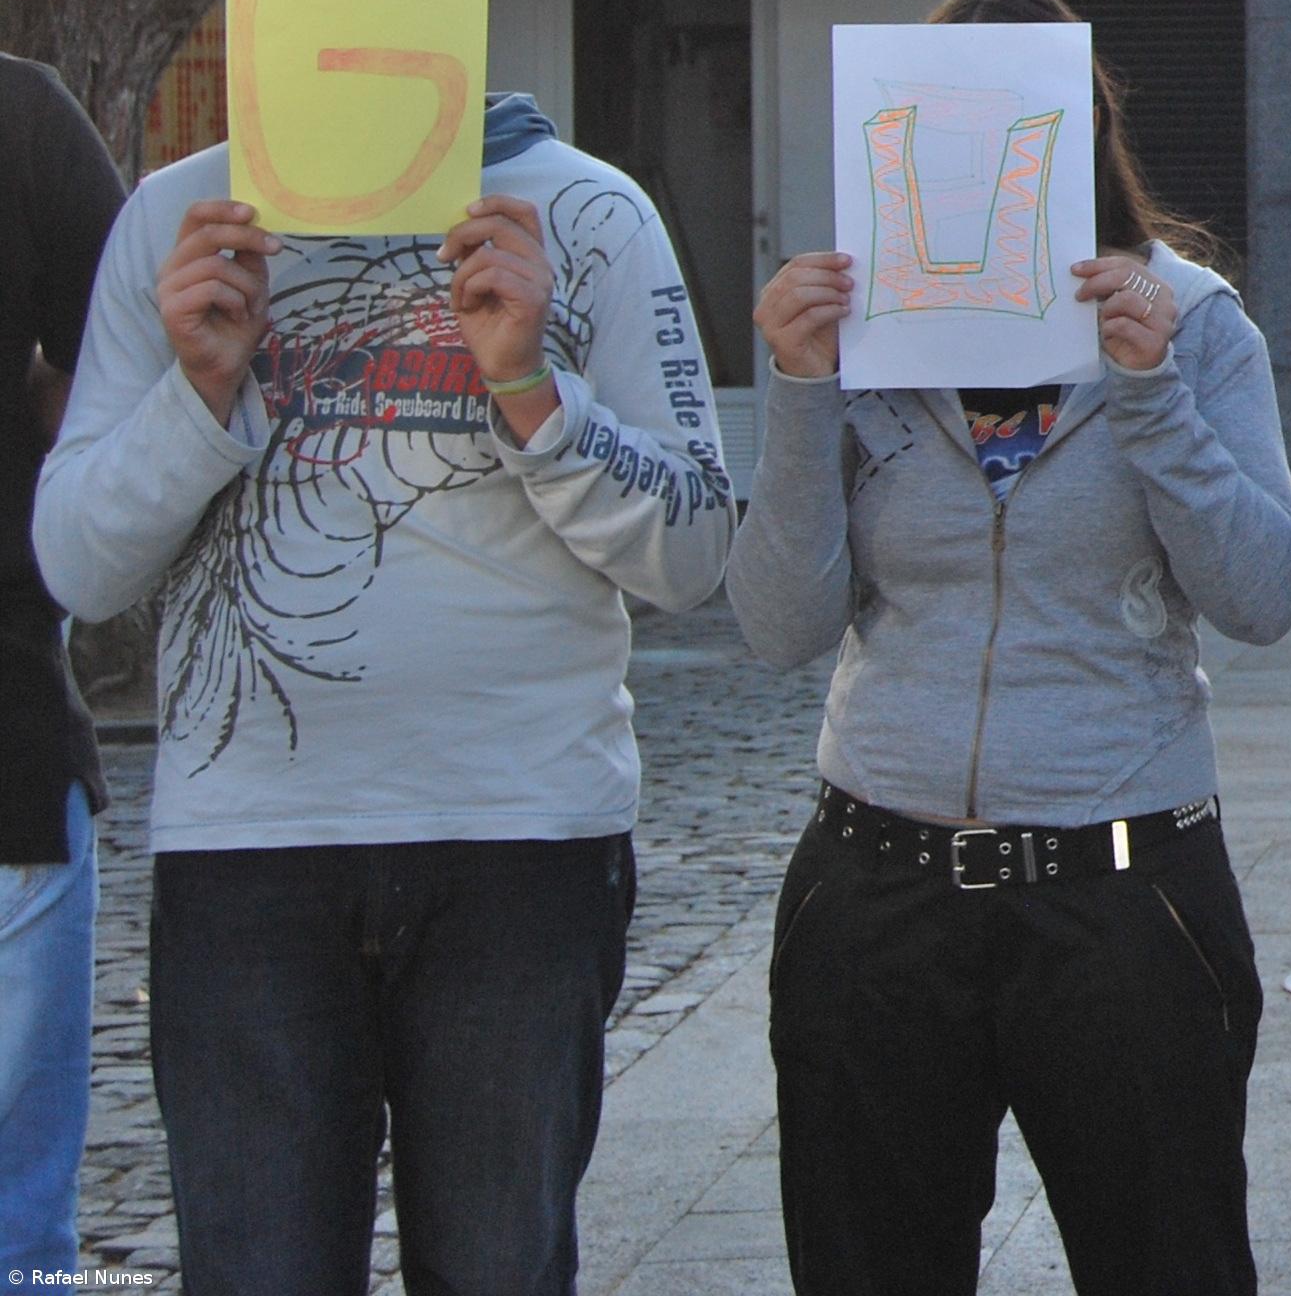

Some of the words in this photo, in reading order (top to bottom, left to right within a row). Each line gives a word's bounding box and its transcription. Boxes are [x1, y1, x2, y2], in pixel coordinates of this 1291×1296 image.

[863, 105, 1065, 321] U
[651, 284, 688, 347] Pro
[660, 358, 706, 429] Ride
